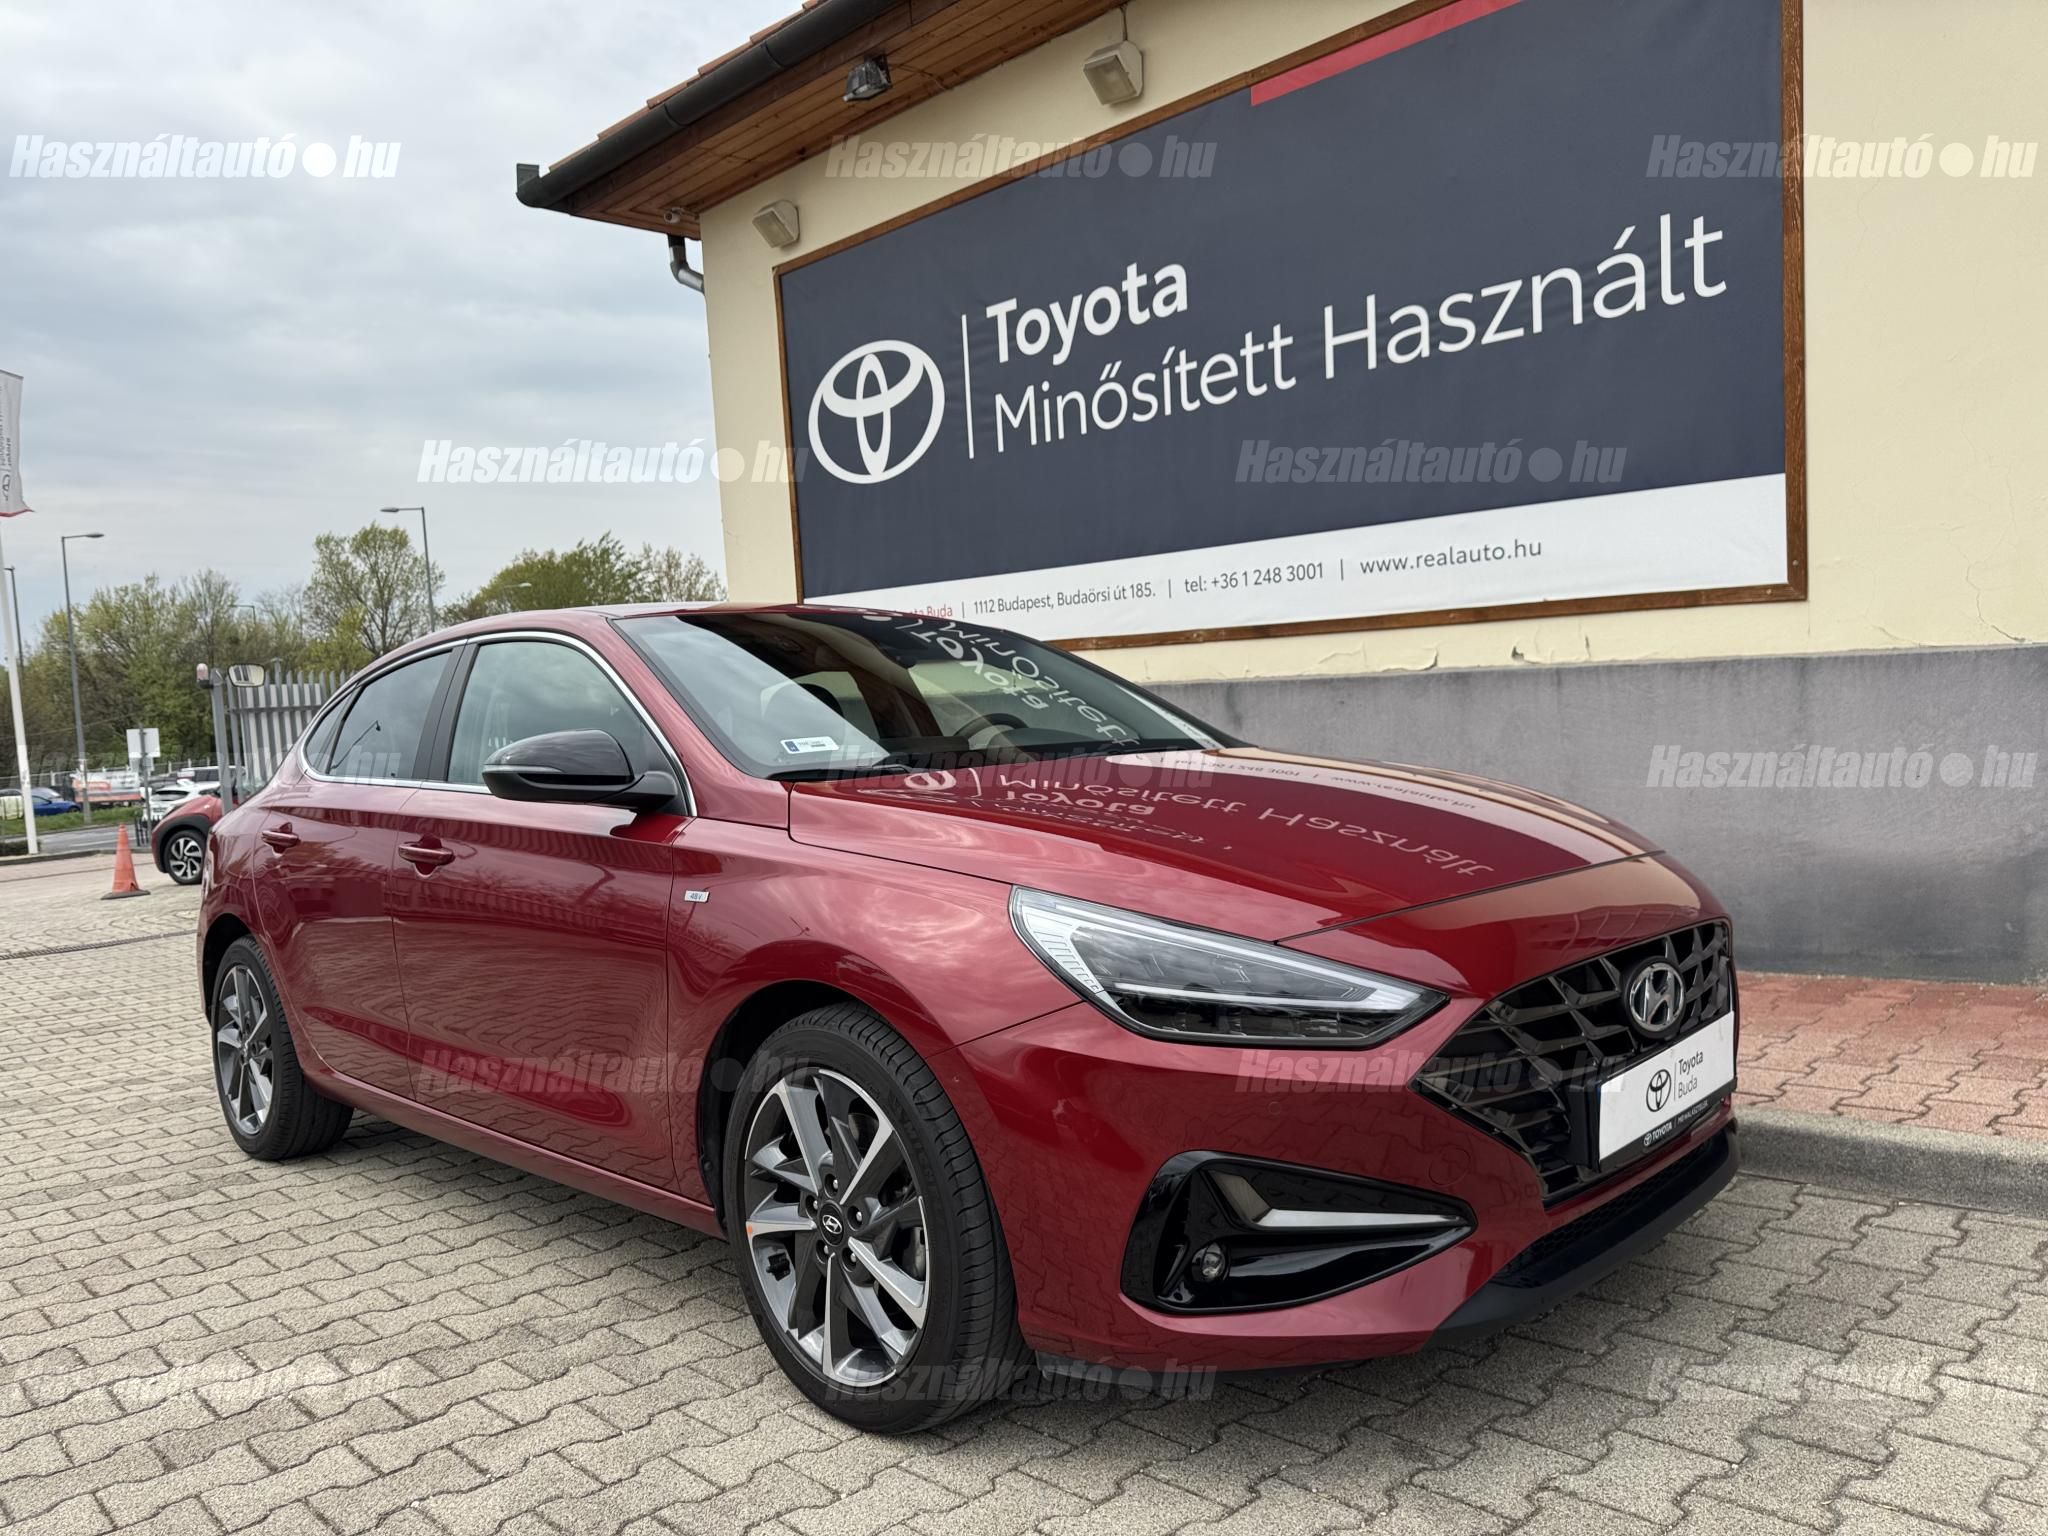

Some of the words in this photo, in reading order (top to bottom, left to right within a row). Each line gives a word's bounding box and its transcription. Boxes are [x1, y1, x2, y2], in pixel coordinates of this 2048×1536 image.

[985, 261, 1188, 366] Toyota
[994, 323, 1297, 453] Minősített
[1323, 212, 1727, 380] Használt
[973, 599, 996, 615] 1112
[997, 594, 1054, 613] Budapest,
[1056, 587, 1111, 607] Budaörsi
[1113, 583, 1128, 601] út
[1129, 581, 1156, 599] 185.
[1184, 575, 1208, 594] tel:
[1252, 566, 1283, 586] 248
[1286, 562, 1325, 583] 3001
[1359, 538, 1543, 575] www.realauto.hu
[1677, 1050, 1704, 1075] Toyota
[1677, 1076, 1698, 1099] Buda
